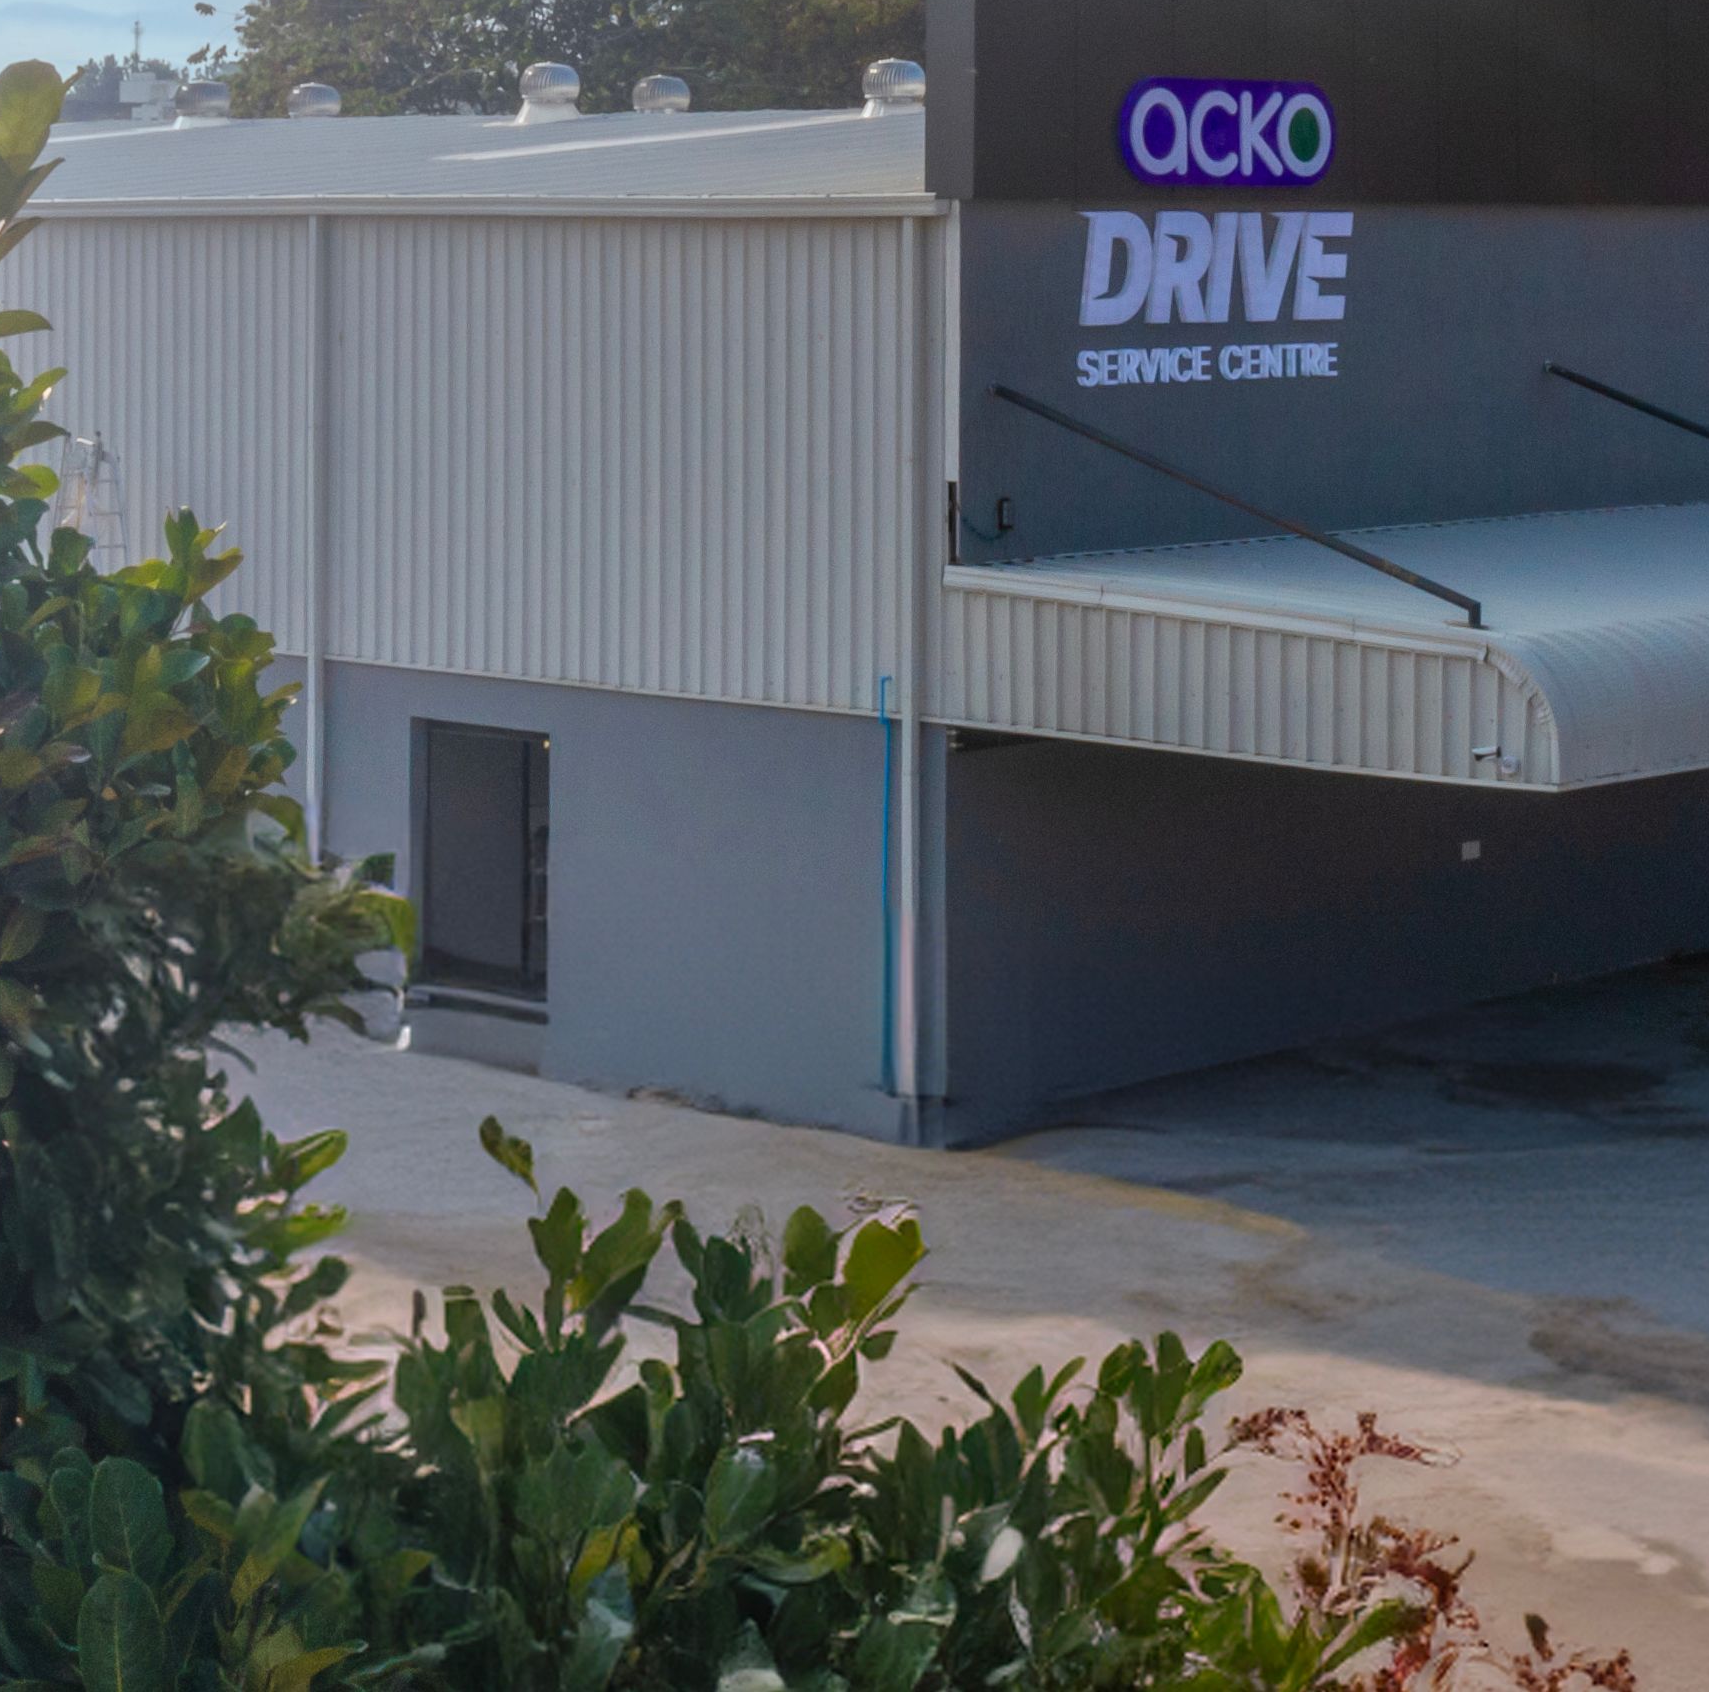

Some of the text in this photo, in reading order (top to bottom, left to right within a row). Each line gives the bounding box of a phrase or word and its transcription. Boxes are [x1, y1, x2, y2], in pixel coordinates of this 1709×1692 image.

[1075, 210, 1354, 326] DRIVE
[1076, 342, 1339, 388] SERVICE CENTRE
